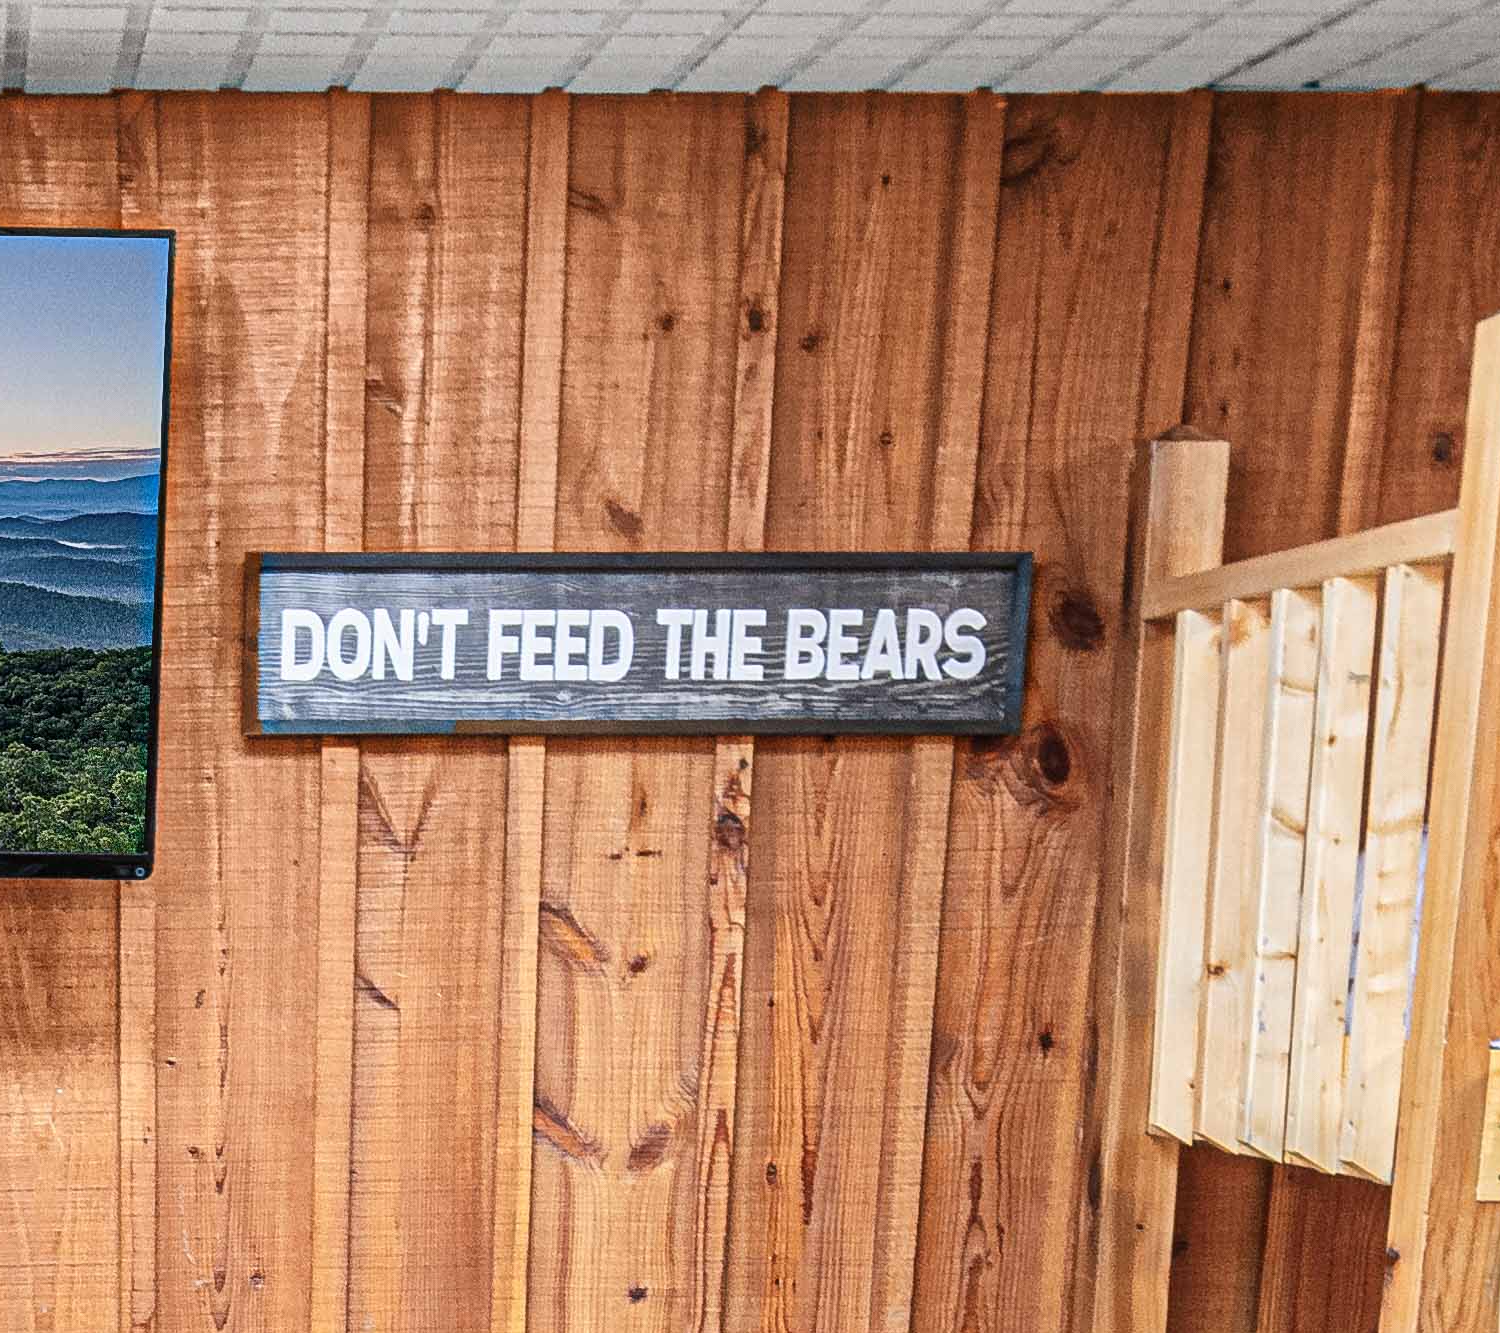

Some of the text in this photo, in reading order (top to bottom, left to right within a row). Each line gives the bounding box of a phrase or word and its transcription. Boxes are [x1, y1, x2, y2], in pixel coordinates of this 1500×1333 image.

[280, 607, 987, 682] DON'T FEED THE BEARS
